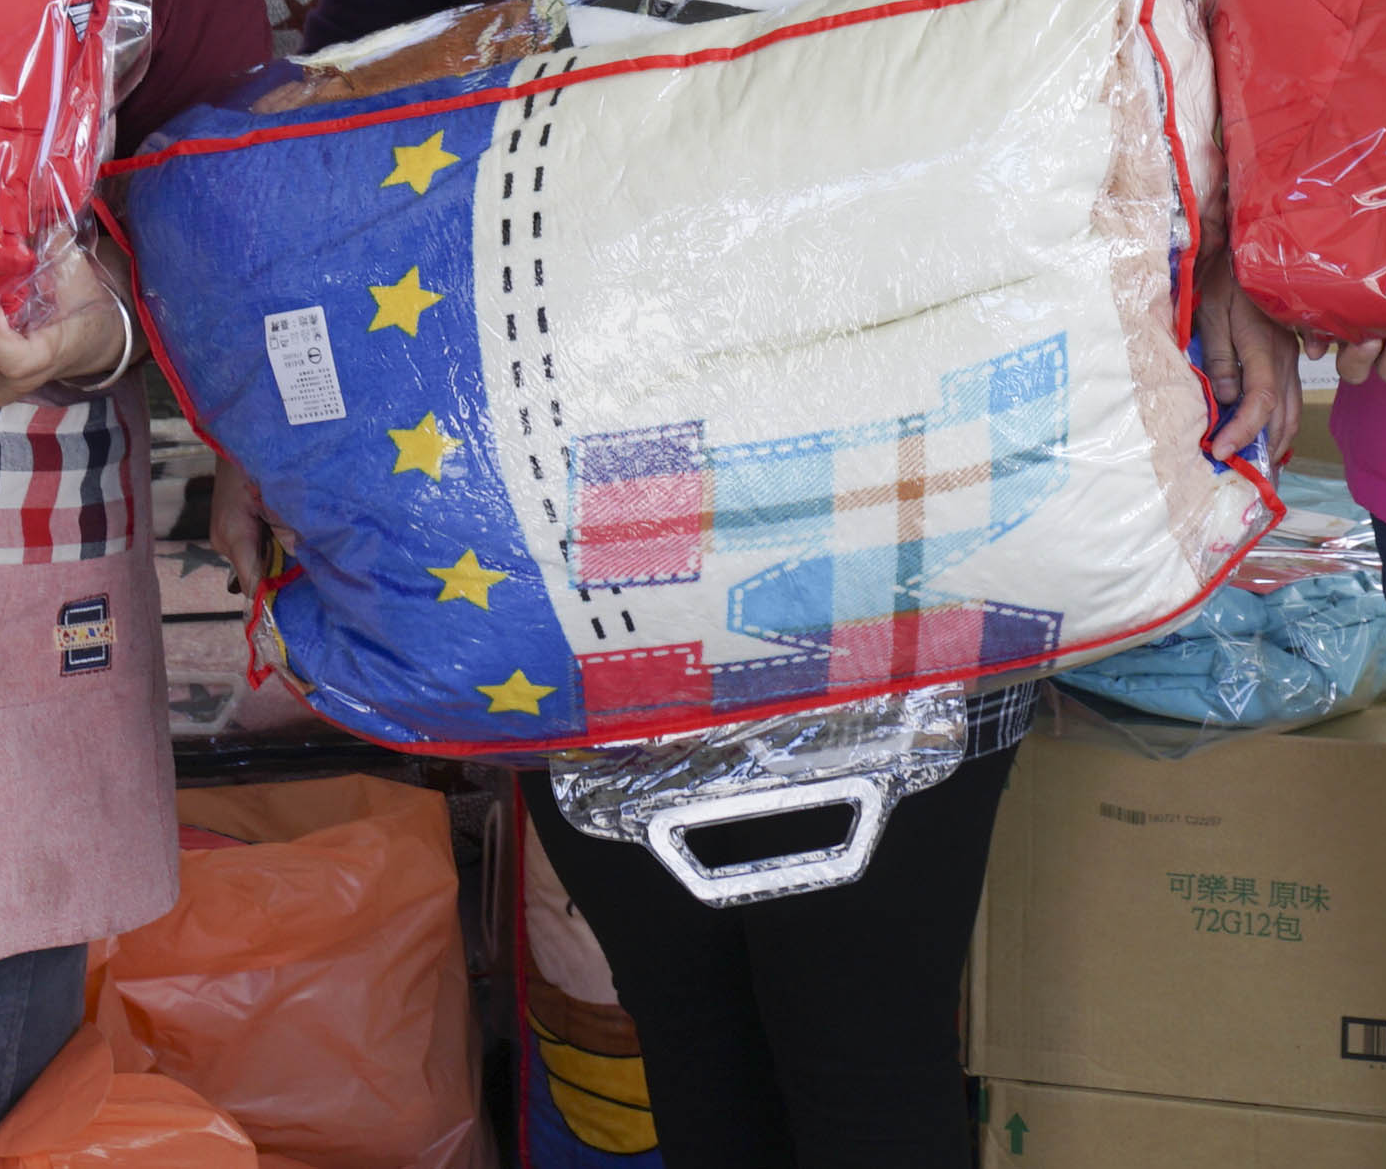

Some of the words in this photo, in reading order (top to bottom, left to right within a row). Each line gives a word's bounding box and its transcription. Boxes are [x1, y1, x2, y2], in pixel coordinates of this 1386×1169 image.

[1165, 870, 1259, 906] 可樂果
[1268, 880, 1332, 912] 原味
[1190, 905, 1304, 943] 72G12包
